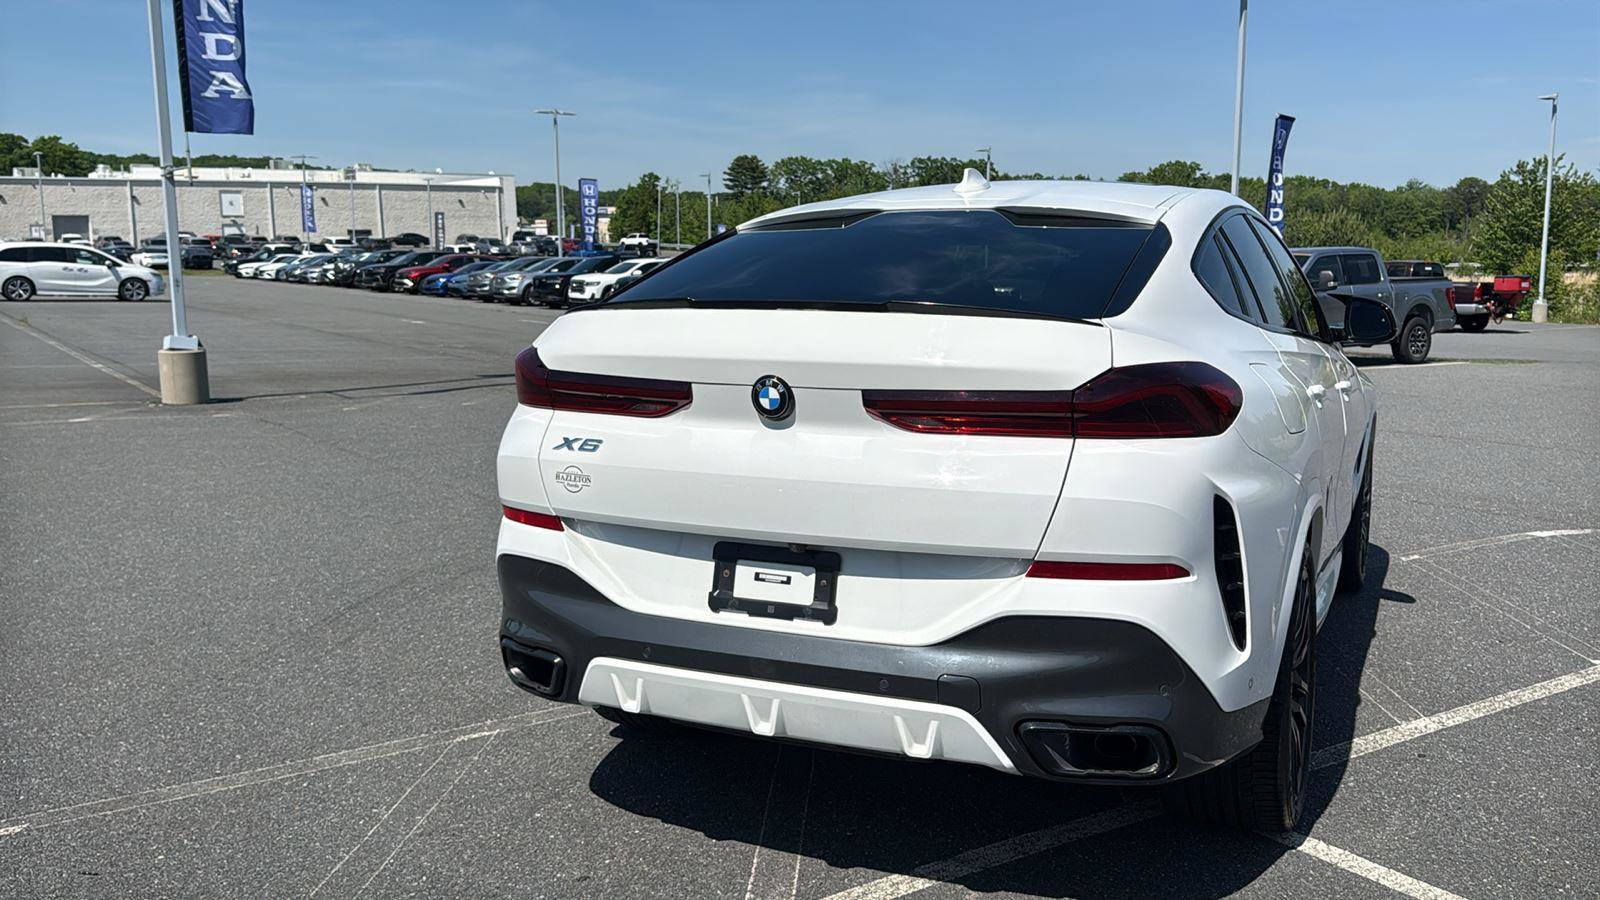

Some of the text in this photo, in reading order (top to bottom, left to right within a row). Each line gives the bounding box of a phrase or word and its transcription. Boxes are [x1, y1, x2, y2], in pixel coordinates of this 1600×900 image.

[583, 198, 596, 243] HONDA
[755, 379, 786, 393] BMW
[552, 437, 603, 452] X6
[555, 473, 591, 484] HAZLETON
